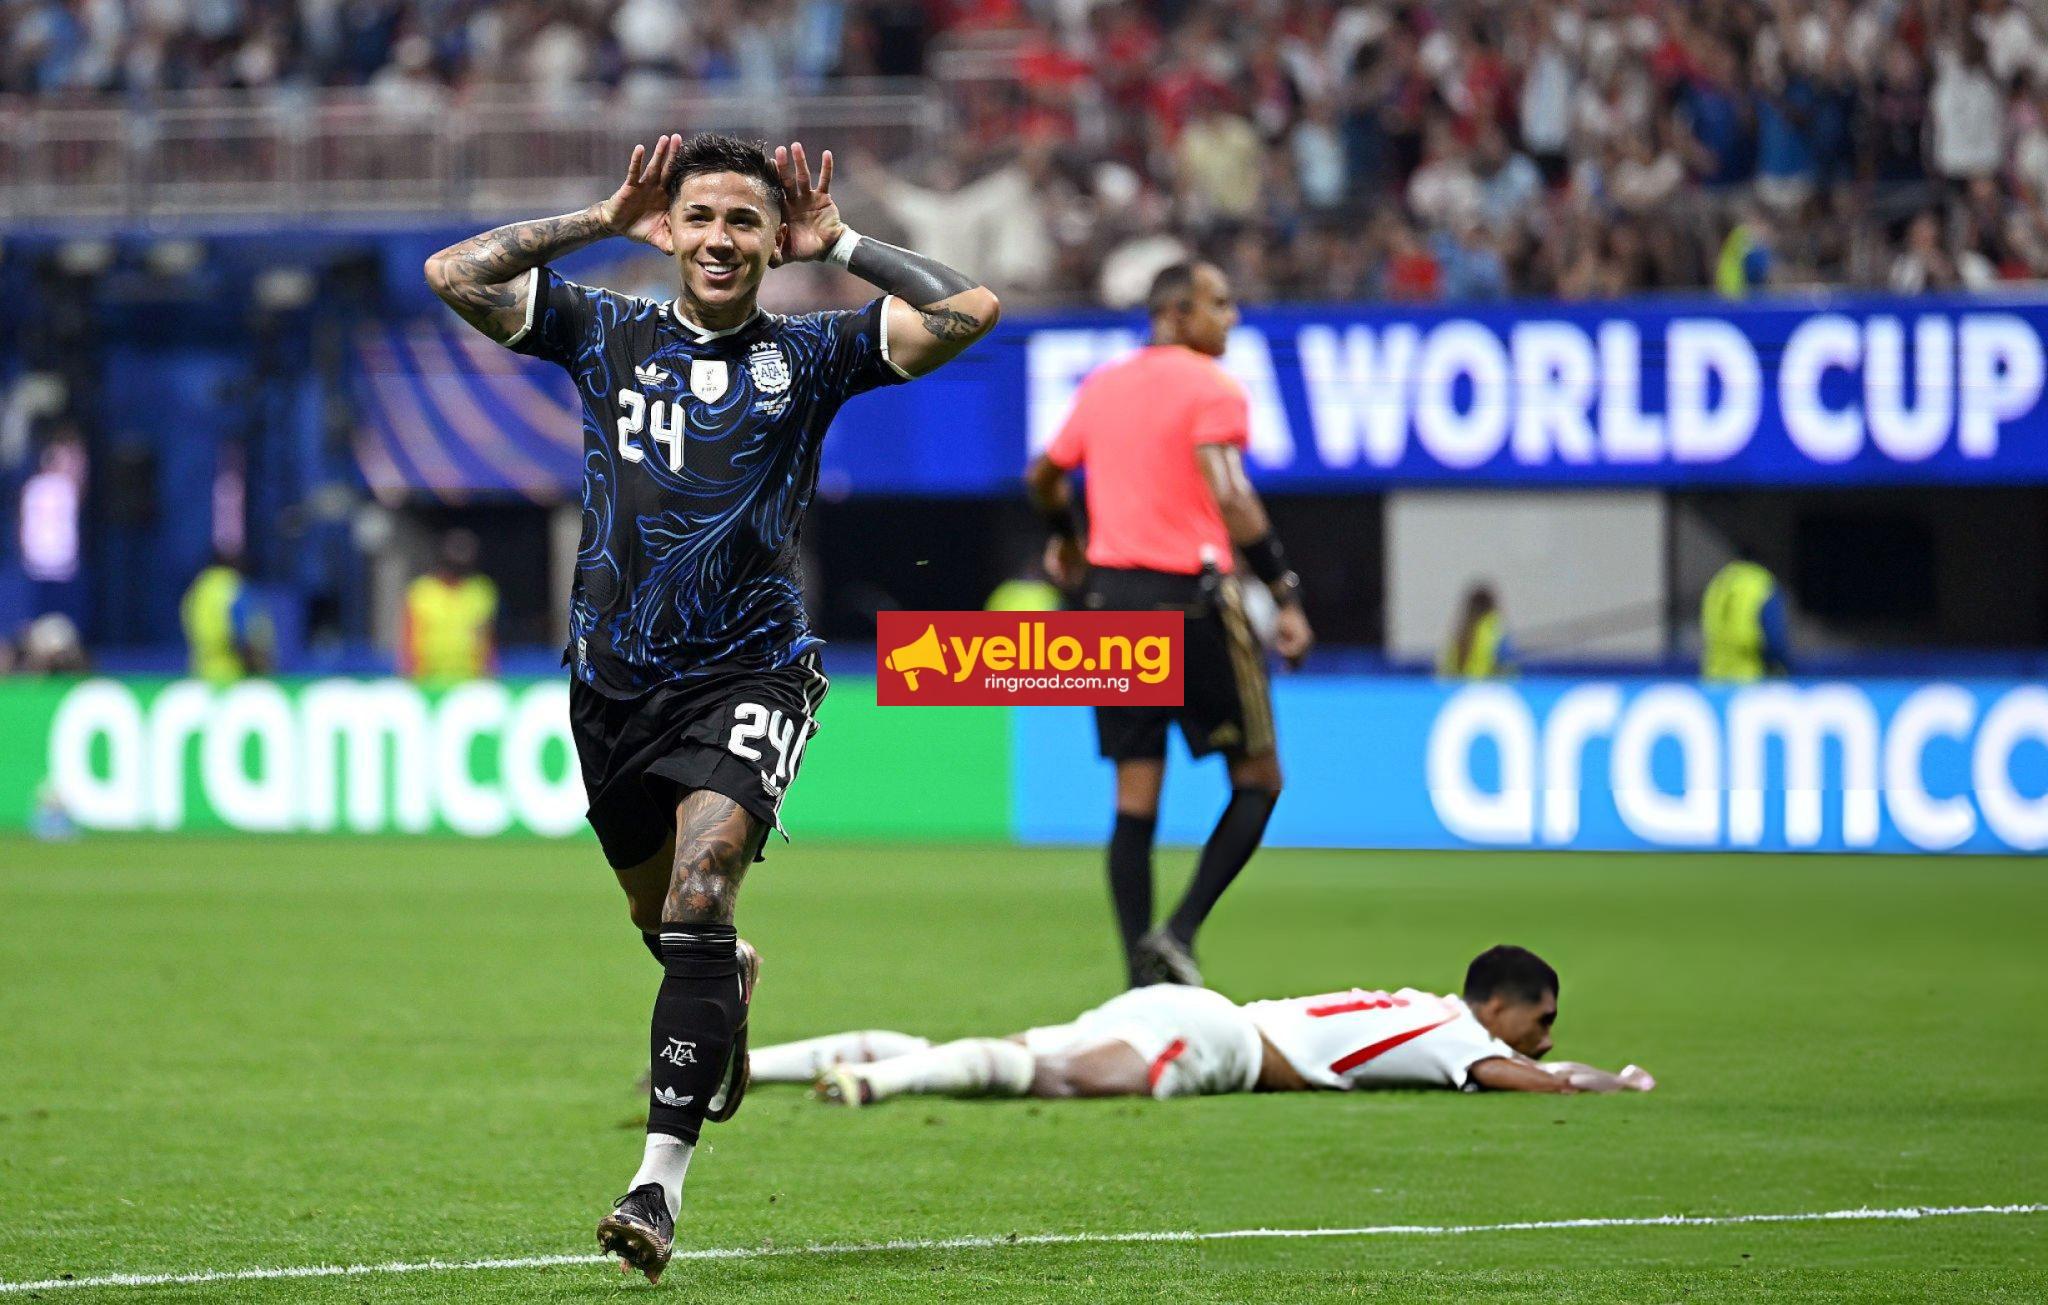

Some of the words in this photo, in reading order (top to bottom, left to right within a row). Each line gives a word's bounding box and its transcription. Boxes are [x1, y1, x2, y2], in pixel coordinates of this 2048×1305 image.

[617, 388, 685, 473] 24
[1026, 325, 1296, 468] FA
[1298, 319, 1763, 468] WORLD
[1780, 314, 2045, 464] CUP
[50, 680, 590, 836] aramco
[728, 702, 795, 778] 24
[1426, 683, 2048, 850] aramco
[659, 1036, 698, 1067] AFA
